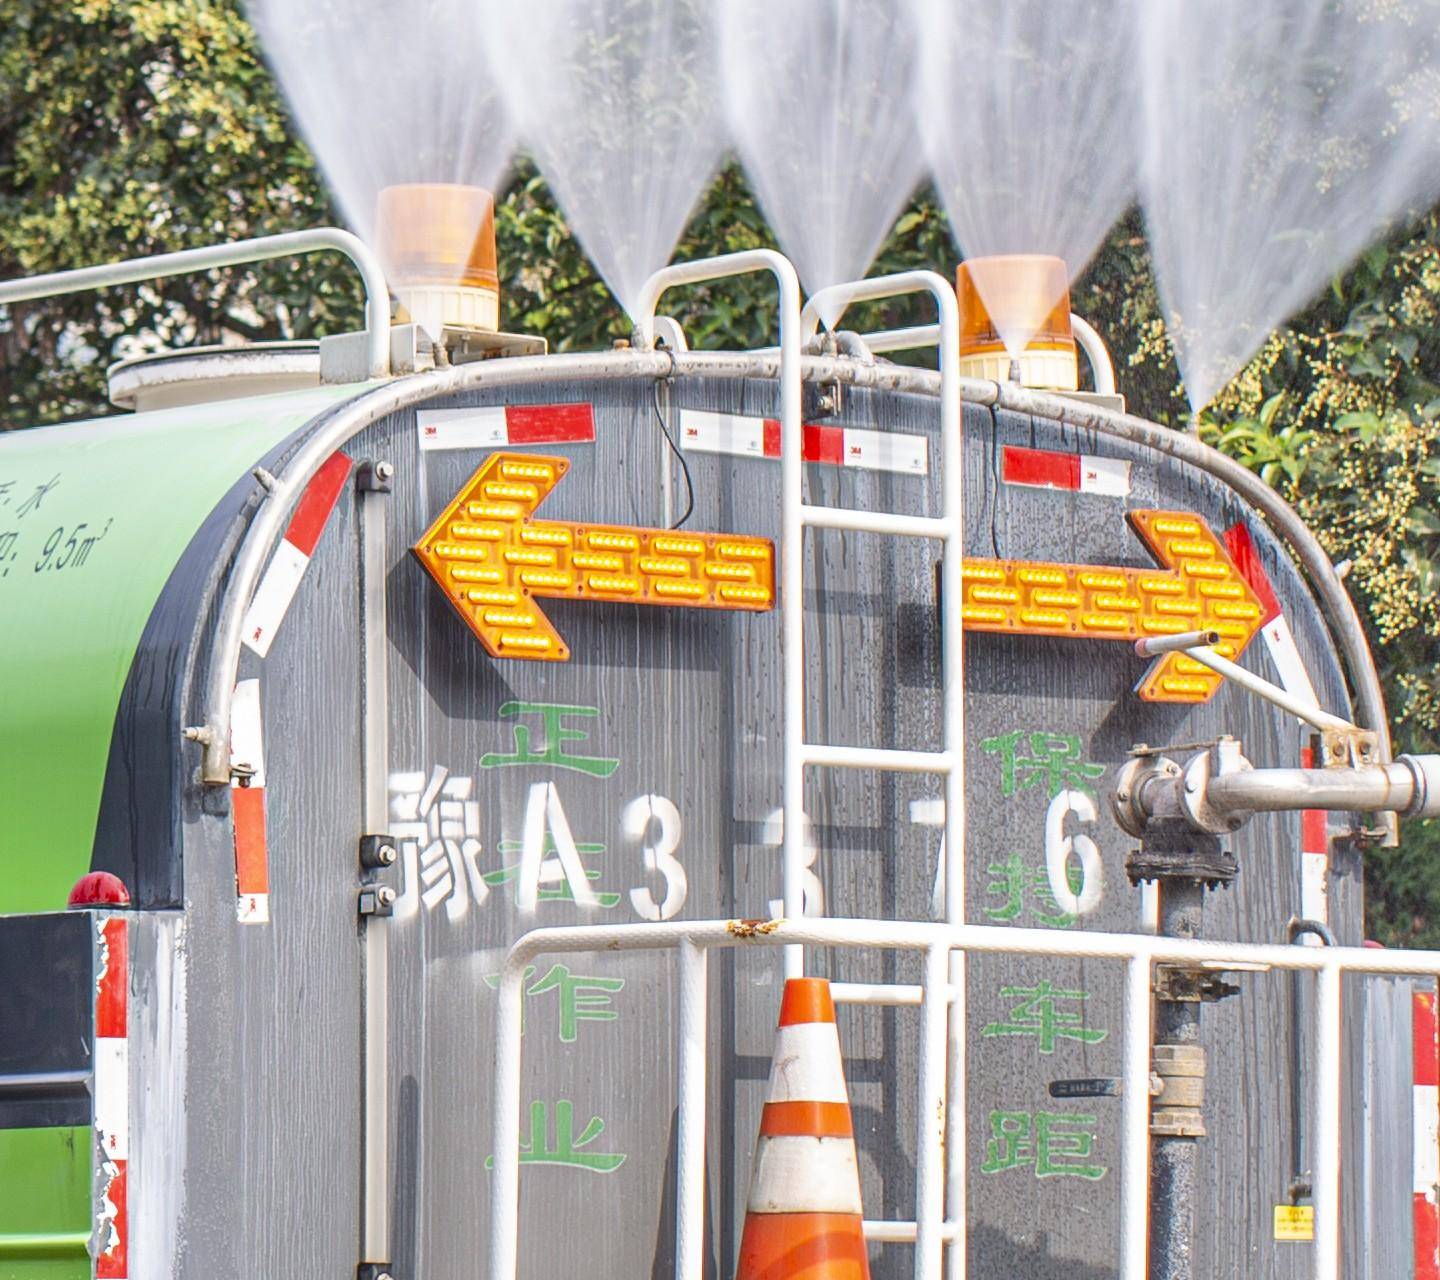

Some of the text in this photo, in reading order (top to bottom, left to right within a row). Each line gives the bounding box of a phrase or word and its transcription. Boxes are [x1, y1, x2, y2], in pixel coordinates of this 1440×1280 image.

[425, 426, 437, 435] 3M
[686, 427, 698, 437] 3M
[850, 446, 862, 455] 3M
[1087, 471, 1097, 480] 3M
